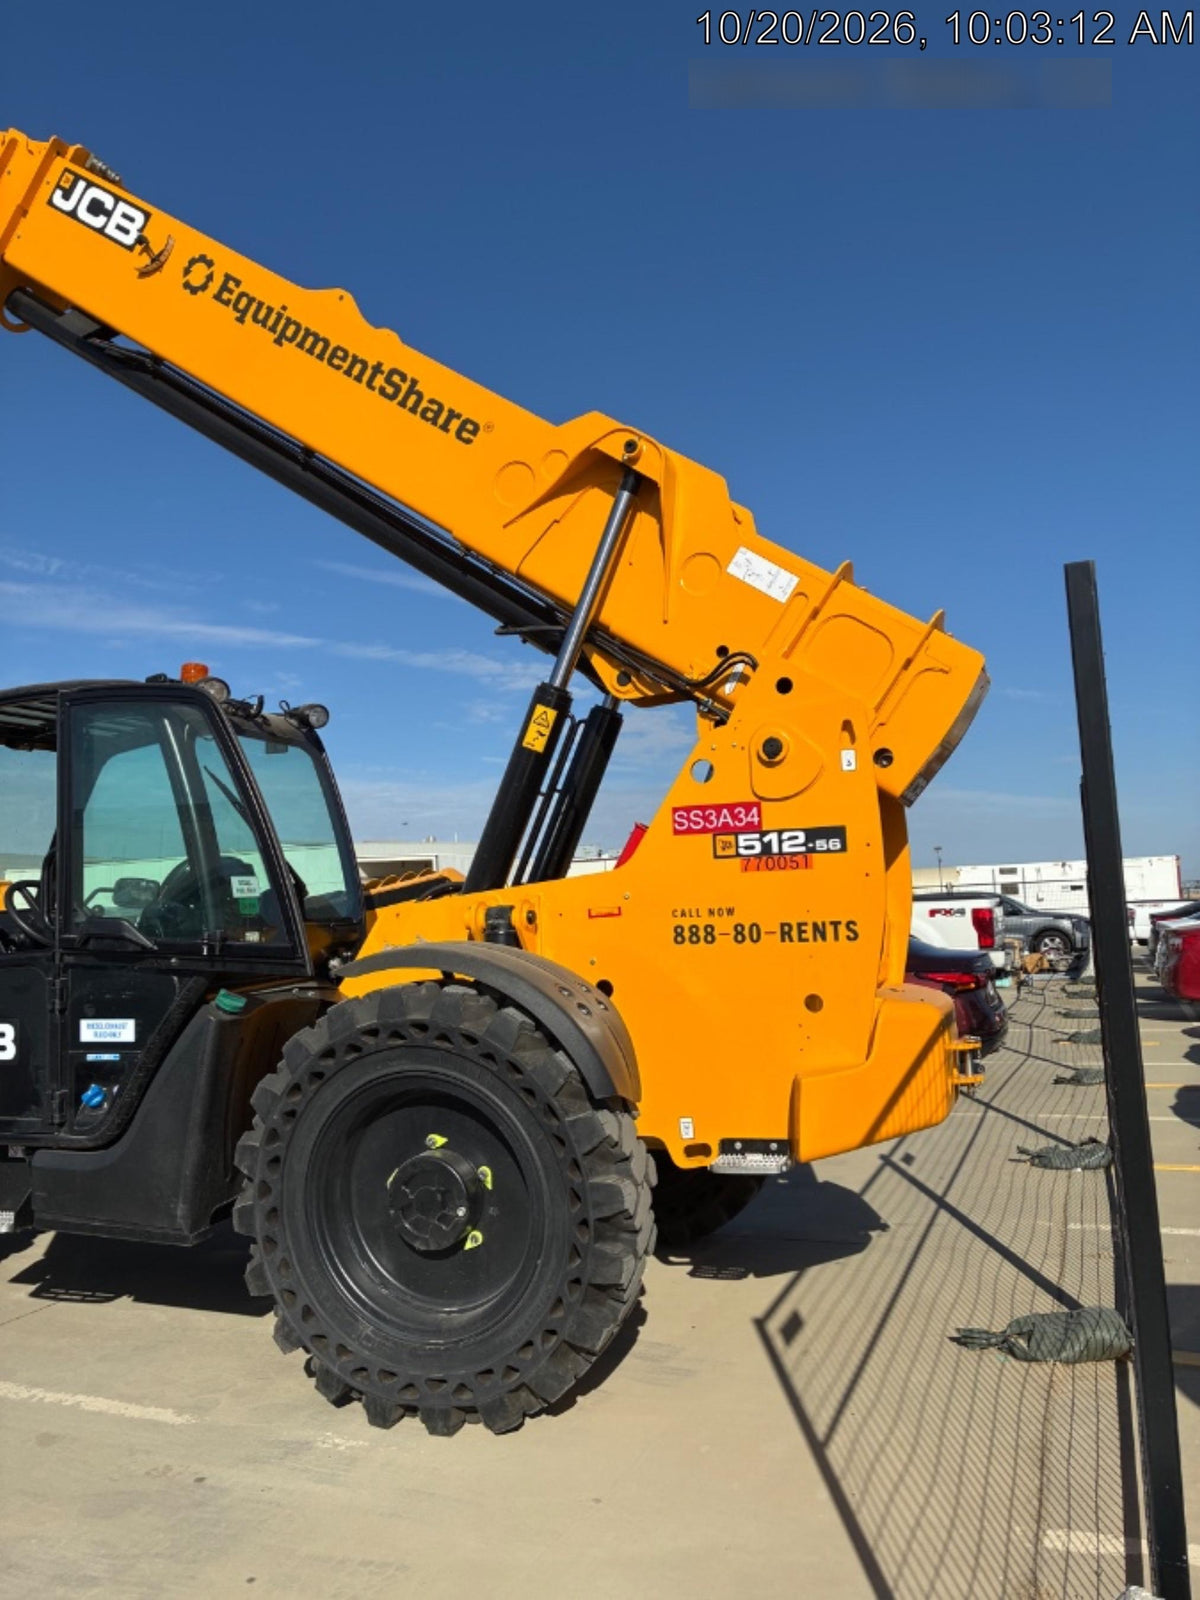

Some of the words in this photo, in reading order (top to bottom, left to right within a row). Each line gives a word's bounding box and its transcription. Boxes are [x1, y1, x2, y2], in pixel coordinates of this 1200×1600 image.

[52, 178, 145, 246] JCB
[213, 272, 481, 445] EquipmentShare
[674, 806, 760, 830] SS3A34
[742, 854, 809, 872] 770051
[672, 908, 702, 918] CALL
[708, 906, 735, 917] NOW
[673, 920, 859, 945] 888-80-RENTS
